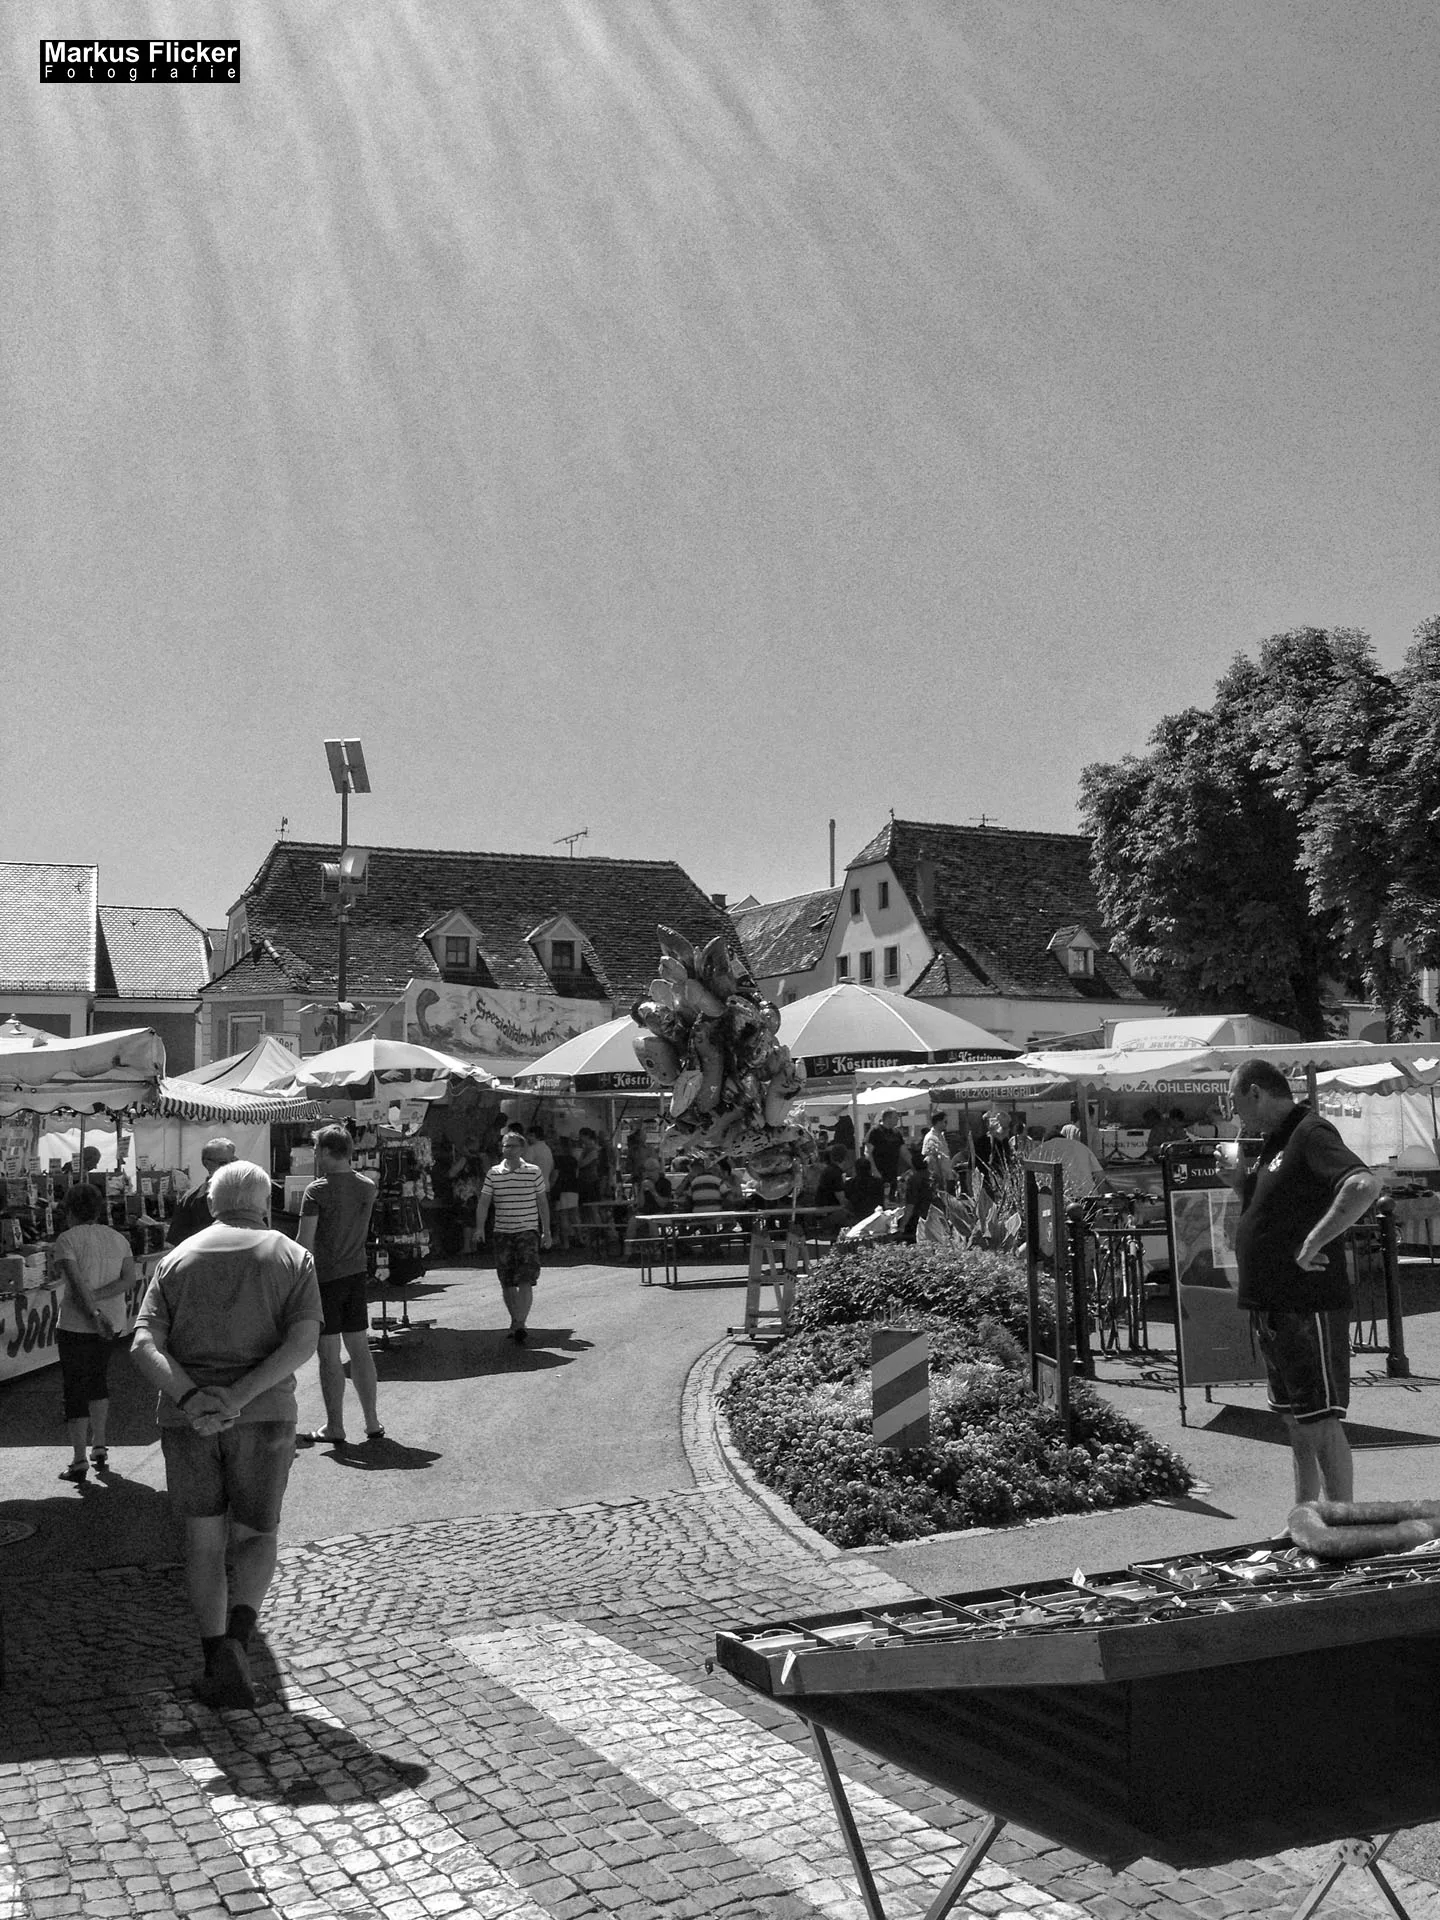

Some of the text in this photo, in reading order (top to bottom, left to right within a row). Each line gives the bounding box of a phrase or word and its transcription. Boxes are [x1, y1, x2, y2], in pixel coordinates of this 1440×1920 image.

[832, 1056, 900, 1074] Köstritzer
[1119, 1082, 1231, 1094] OLZKOHLENGRIL
[1191, 1168, 1217, 1177] STAD
